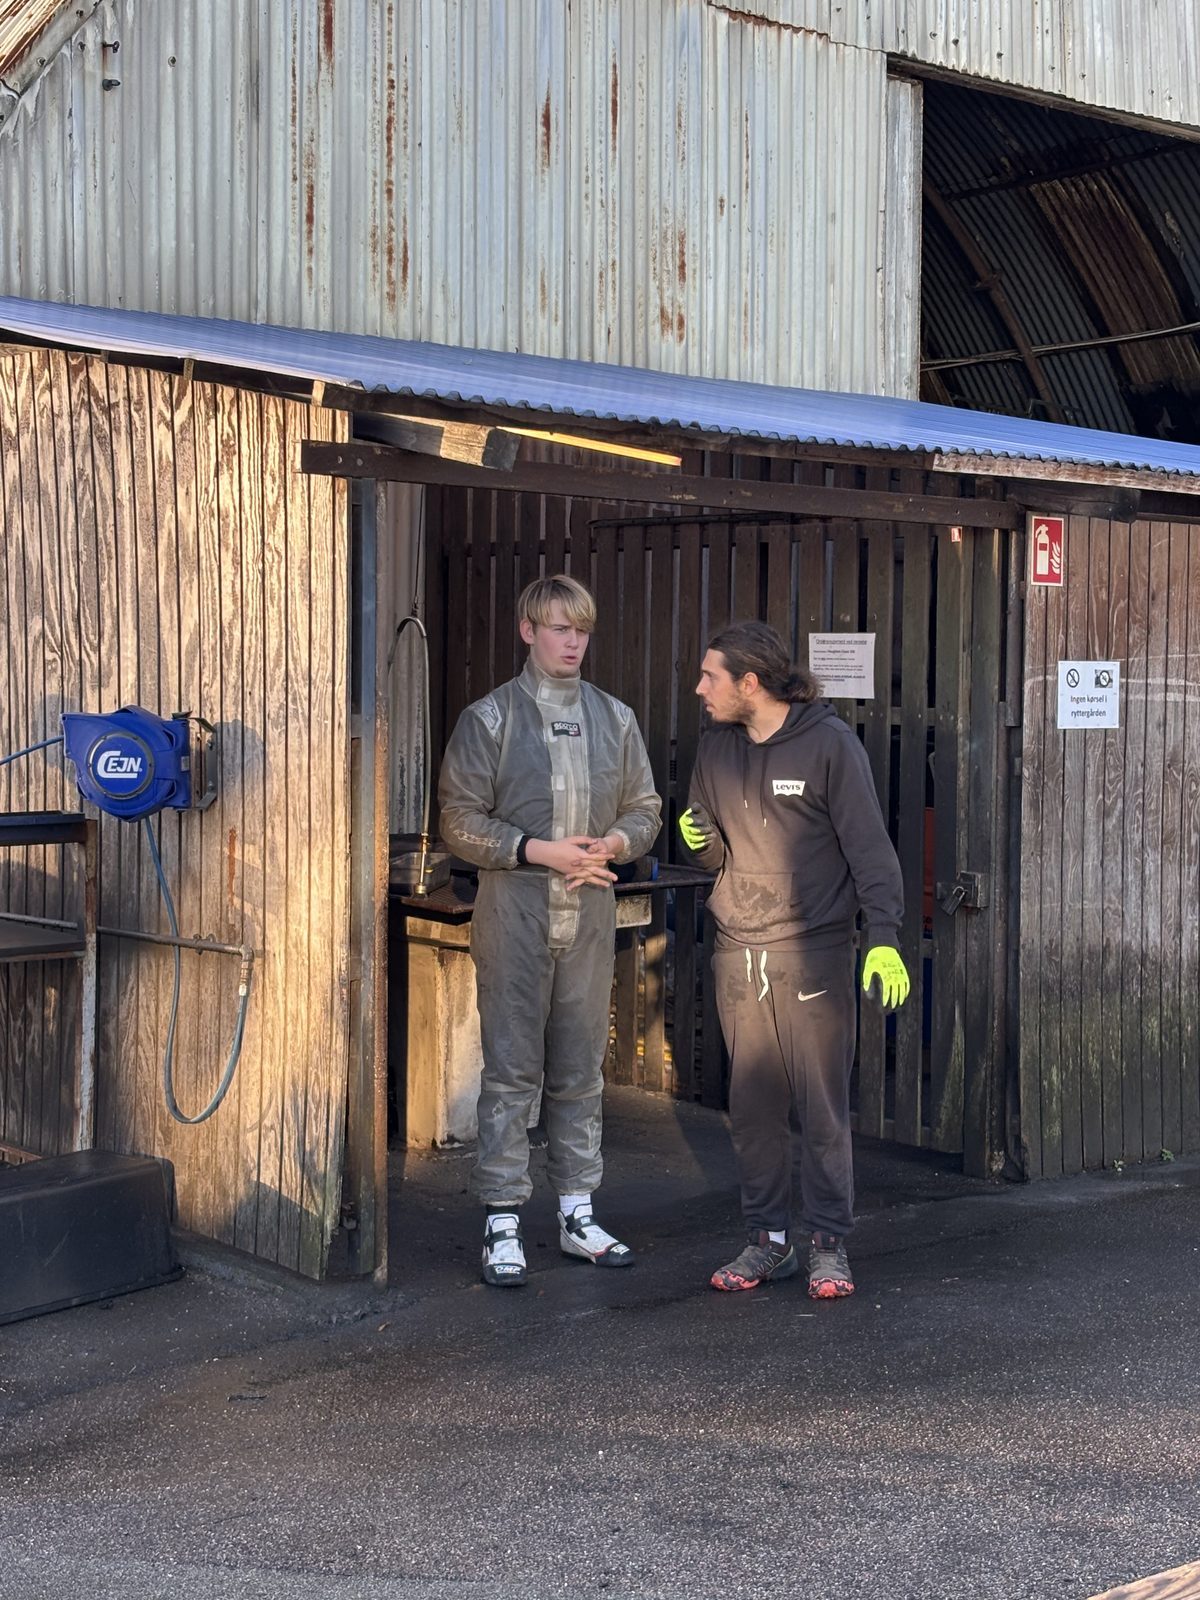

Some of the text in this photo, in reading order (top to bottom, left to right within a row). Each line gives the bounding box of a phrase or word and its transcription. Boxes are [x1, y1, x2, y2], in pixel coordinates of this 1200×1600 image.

[1070, 695, 1086, 704] Ingen
[1086, 694, 1105, 703] kørsel
[1070, 708, 1107, 718] ryttergården
[97, 750, 142, 779] CEJN
